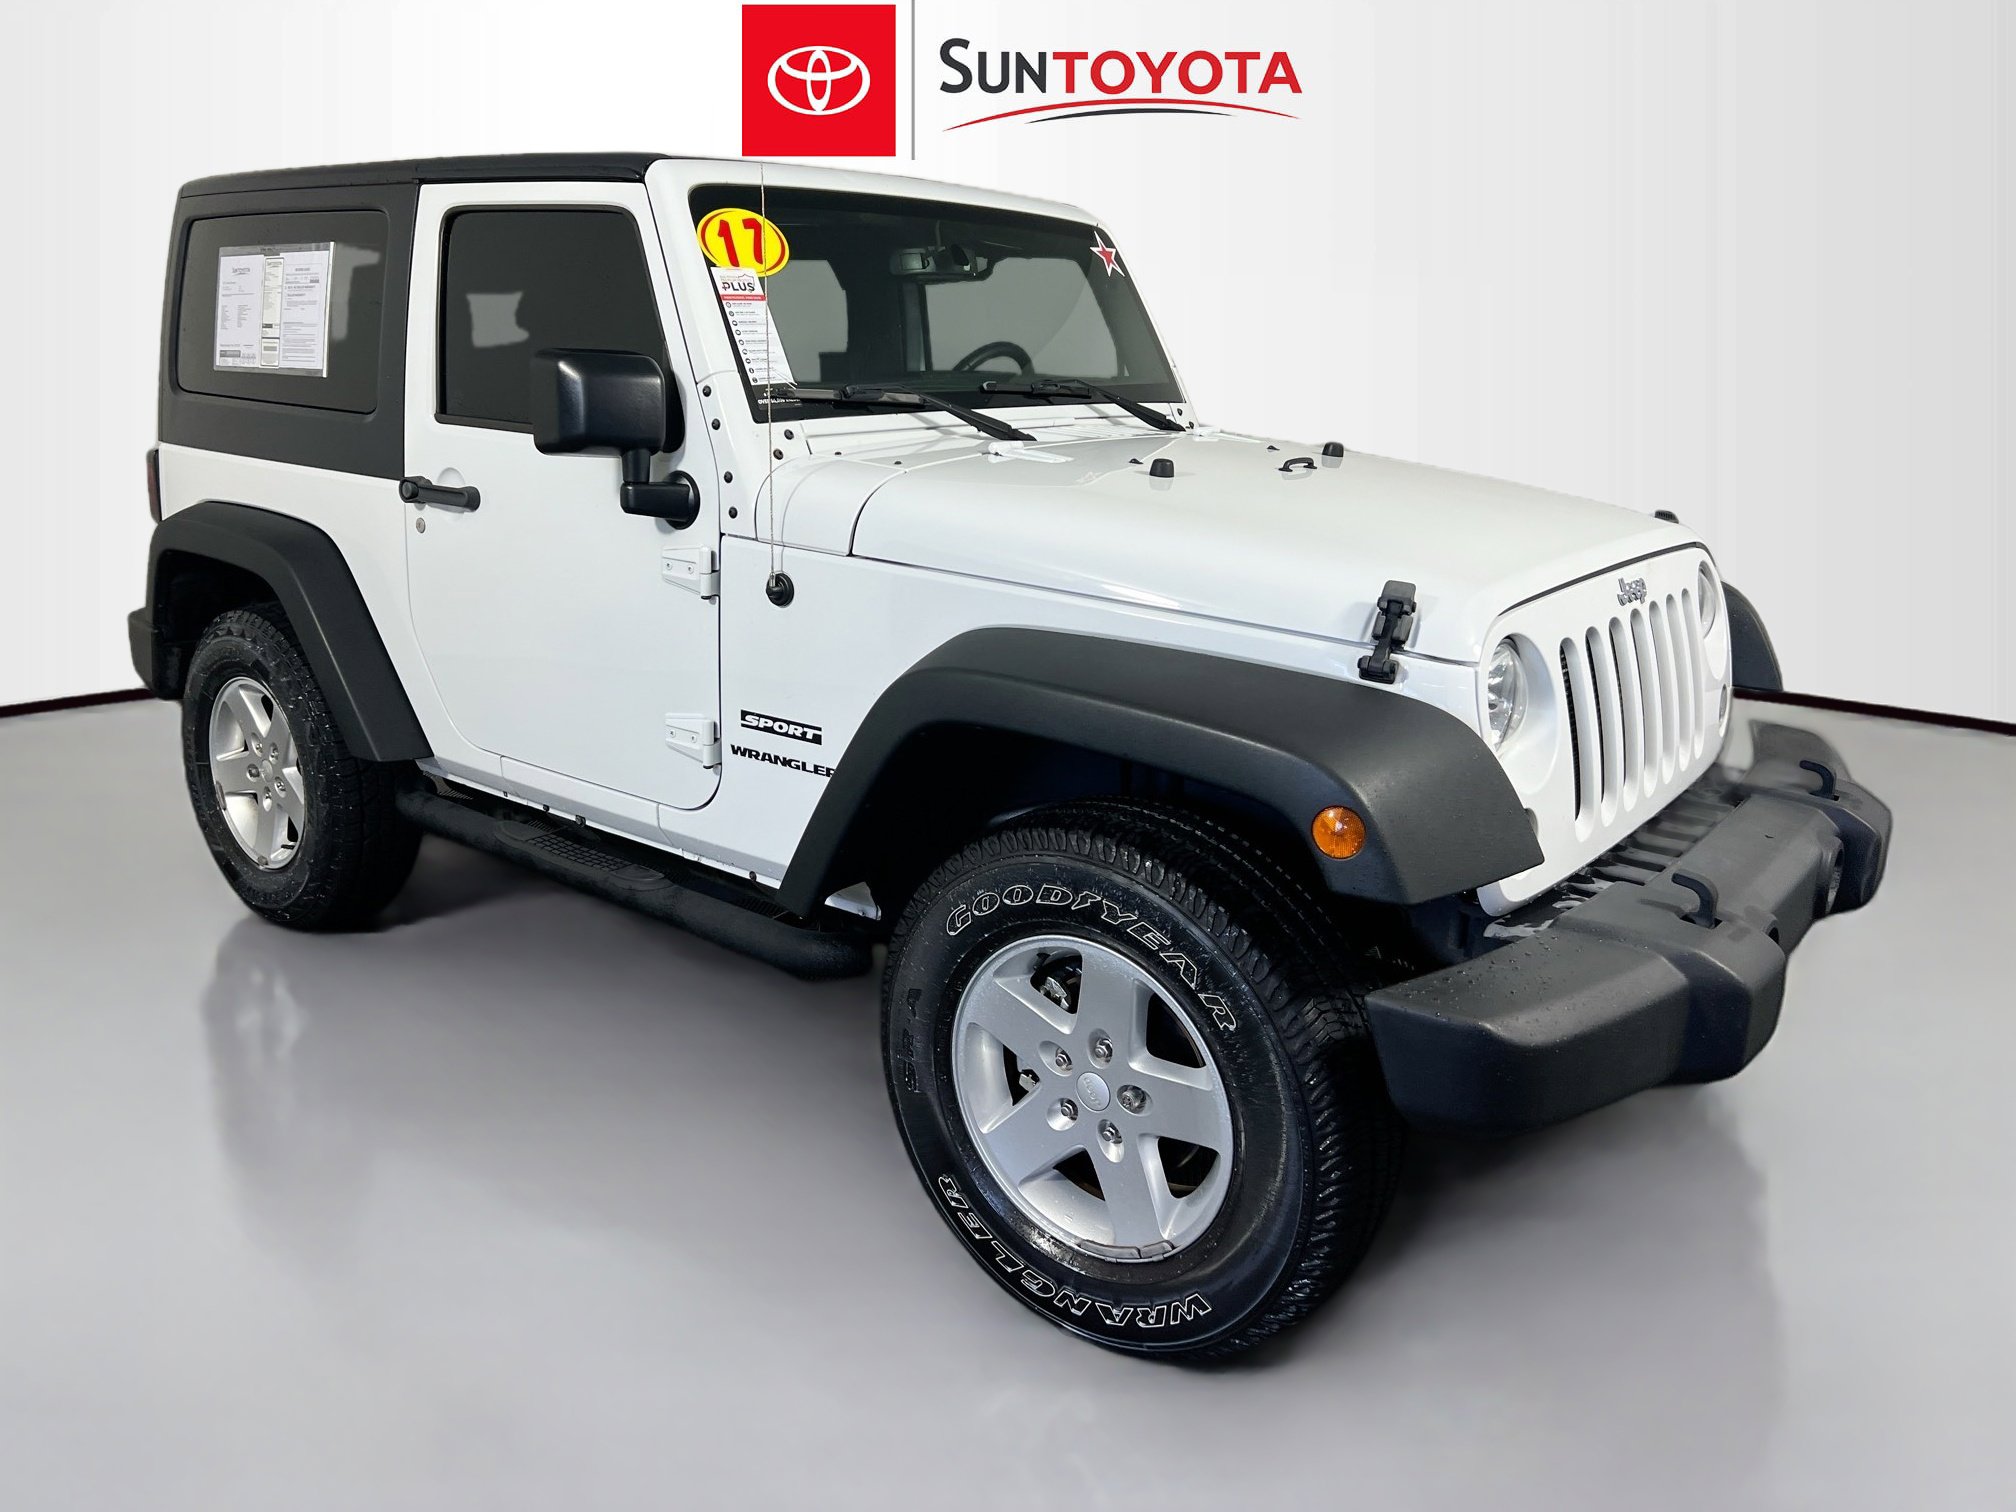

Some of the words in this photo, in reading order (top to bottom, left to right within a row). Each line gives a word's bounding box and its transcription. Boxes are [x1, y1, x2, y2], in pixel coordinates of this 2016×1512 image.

[718, 218, 763, 267] 17
[721, 281, 755, 292] PLUS
[1617, 578, 1647, 606] Jeep
[745, 714, 822, 739] SPORT
[946, 884, 1236, 1030] GOODYEAR
[938, 1173, 1212, 1328] WRANGLER
